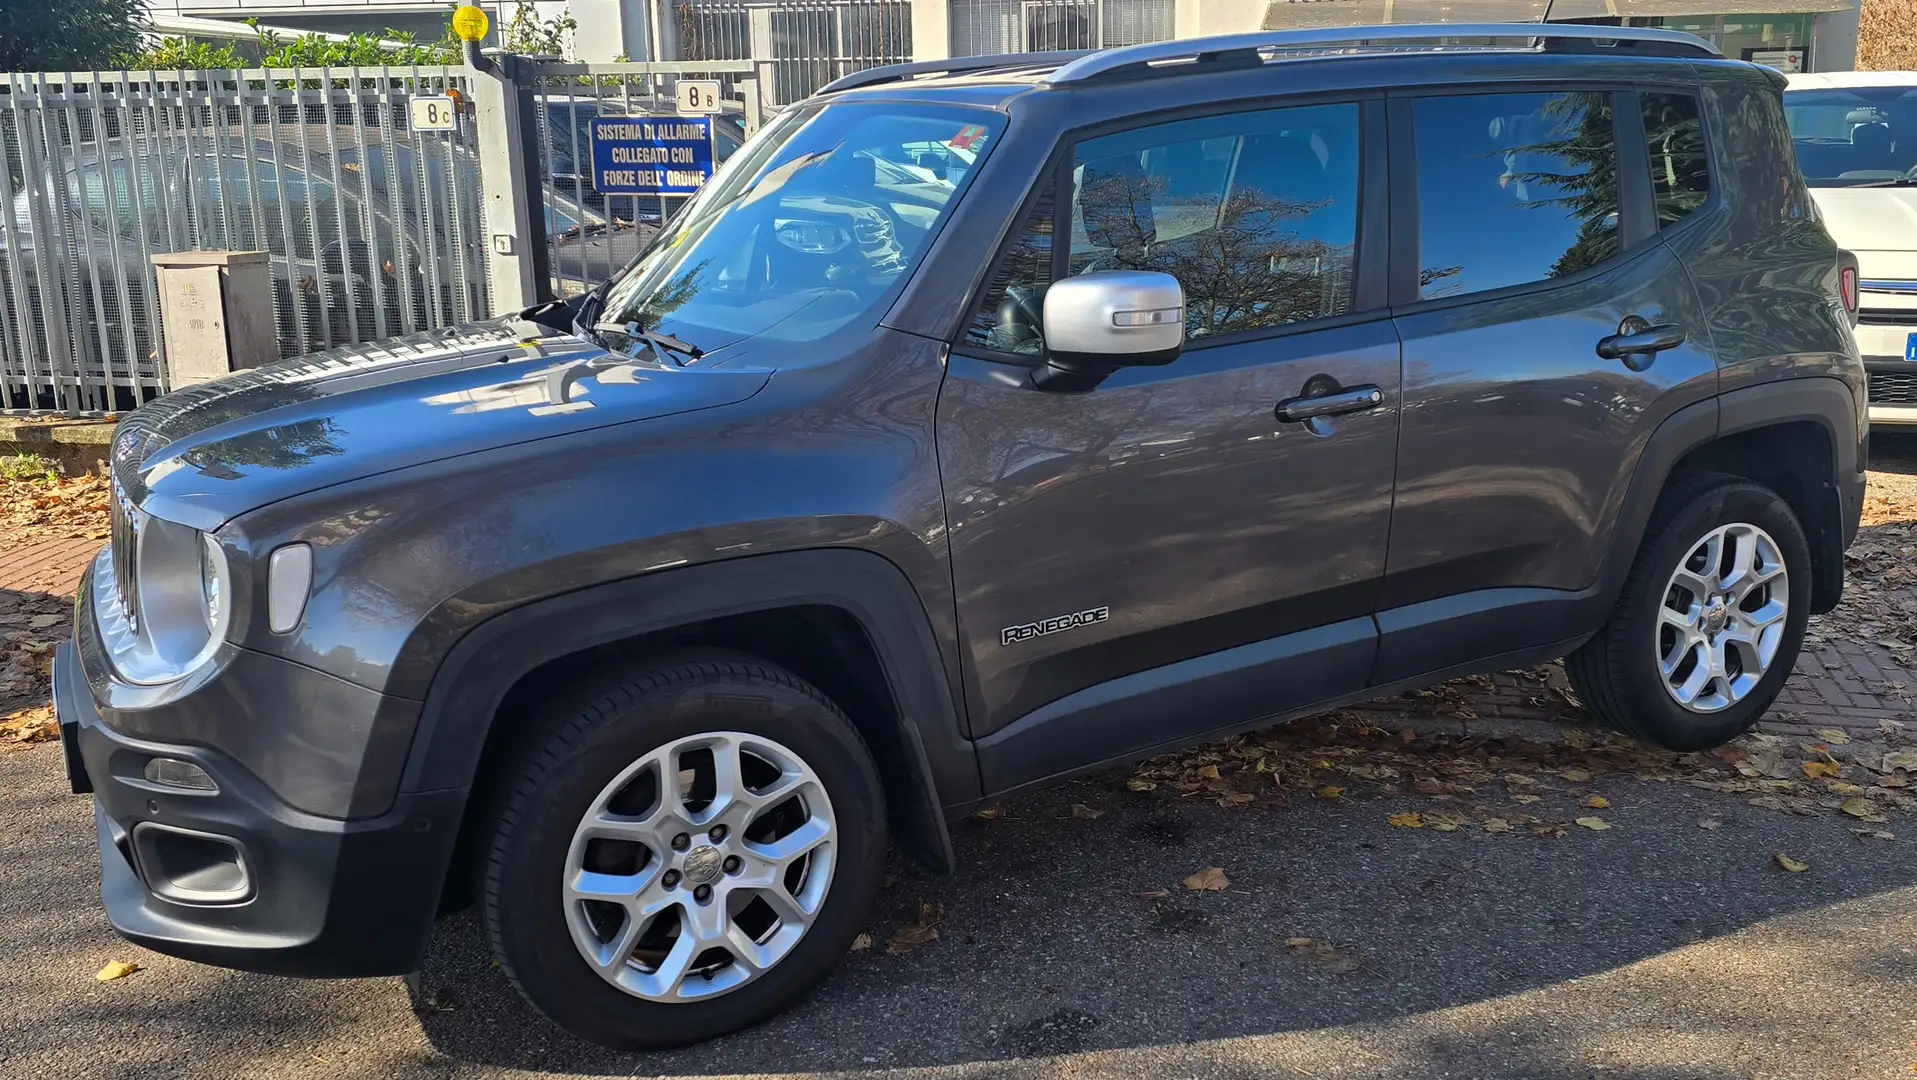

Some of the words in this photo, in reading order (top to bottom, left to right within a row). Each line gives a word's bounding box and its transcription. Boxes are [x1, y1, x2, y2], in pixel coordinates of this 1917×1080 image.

[690, 86, 699, 107] 8
[706, 95, 713, 107] B
[428, 103, 437, 124] 8
[597, 124, 642, 140] SISTEMA
[644, 124, 655, 140] DI
[658, 124, 706, 140] ALLARME
[611, 147, 668, 163] COLLEGATO
[671, 147, 693, 163] CON
[603, 170, 636, 186] FORZE
[637, 170, 663, 187] DELL'
[666, 170, 706, 187] ORDINE
[1001, 606, 1109, 645] RENEGADE
